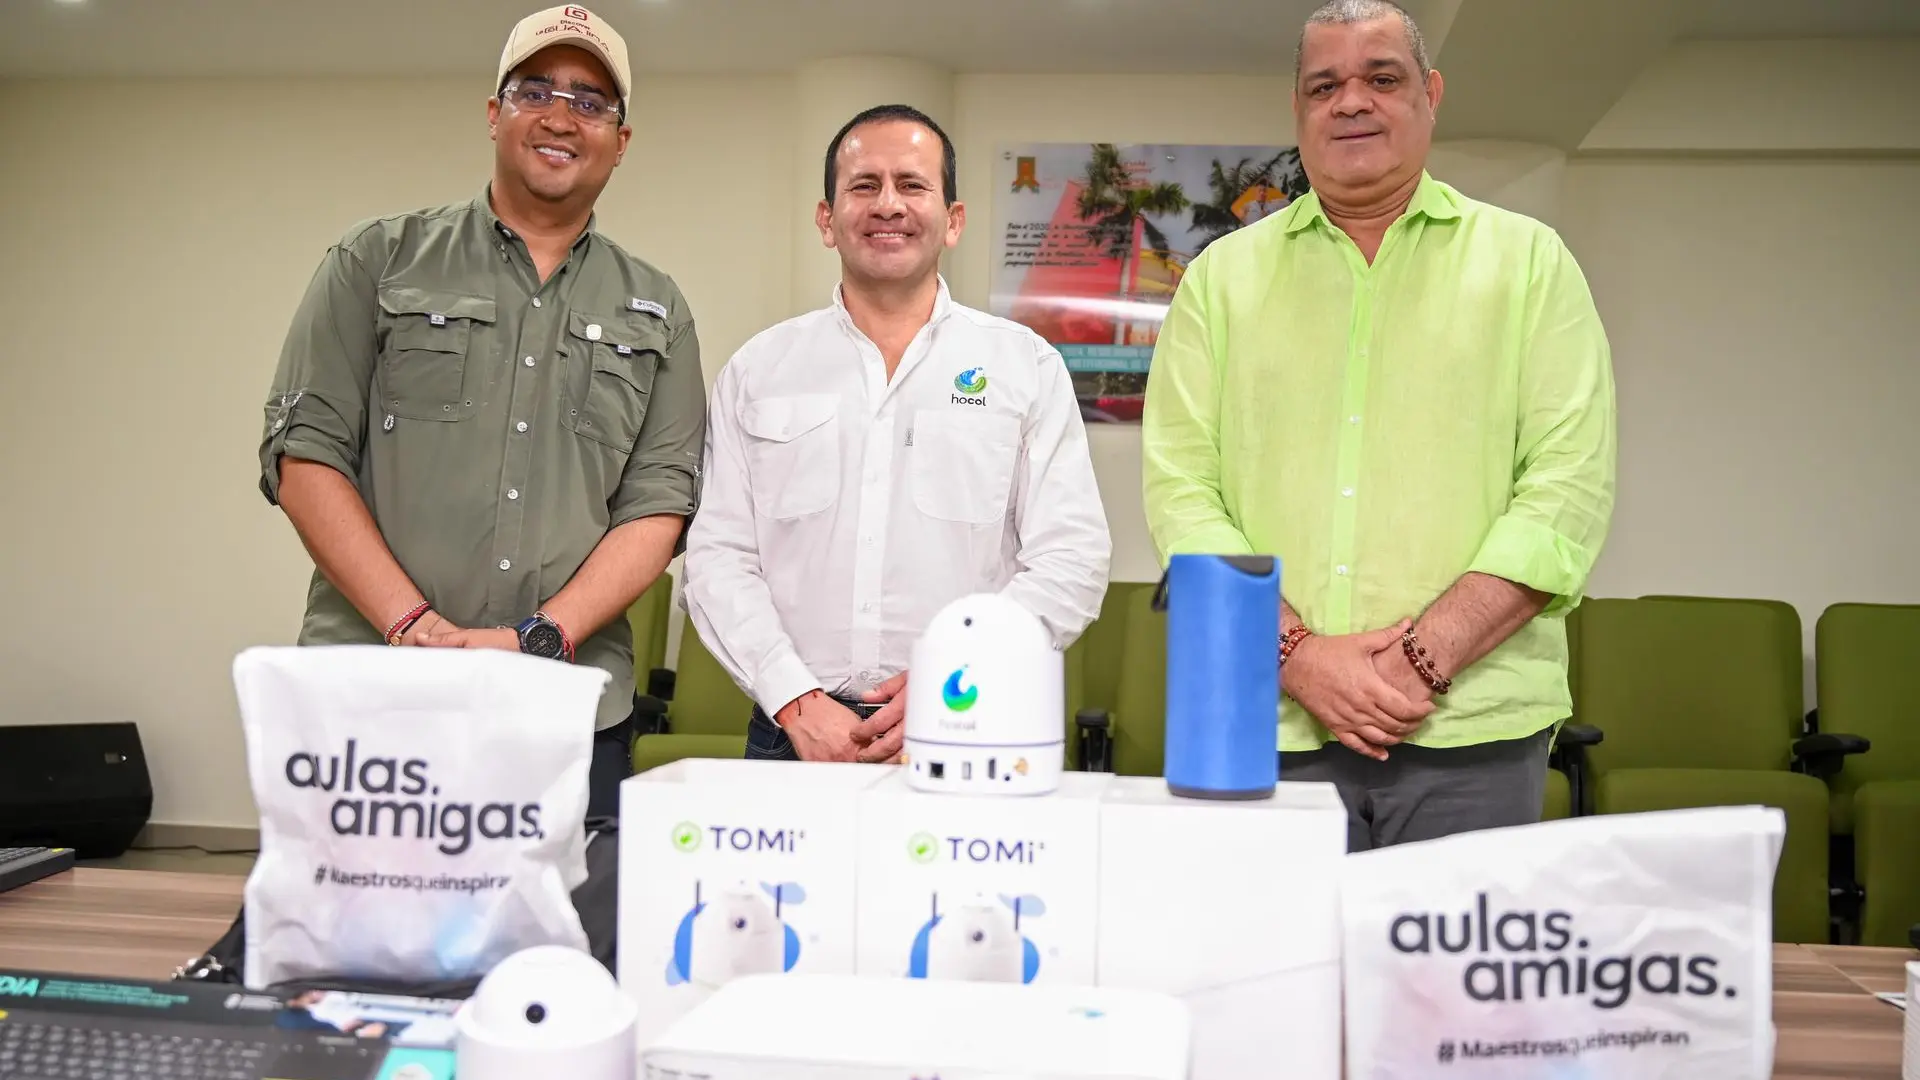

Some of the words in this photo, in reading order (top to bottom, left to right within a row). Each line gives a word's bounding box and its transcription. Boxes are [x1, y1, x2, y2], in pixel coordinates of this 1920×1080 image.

[951, 393, 987, 406] hocol
[285, 738, 439, 795] aulas.
[1389, 892, 1589, 953] aulas.
[1463, 952, 1739, 1010] amigas.
